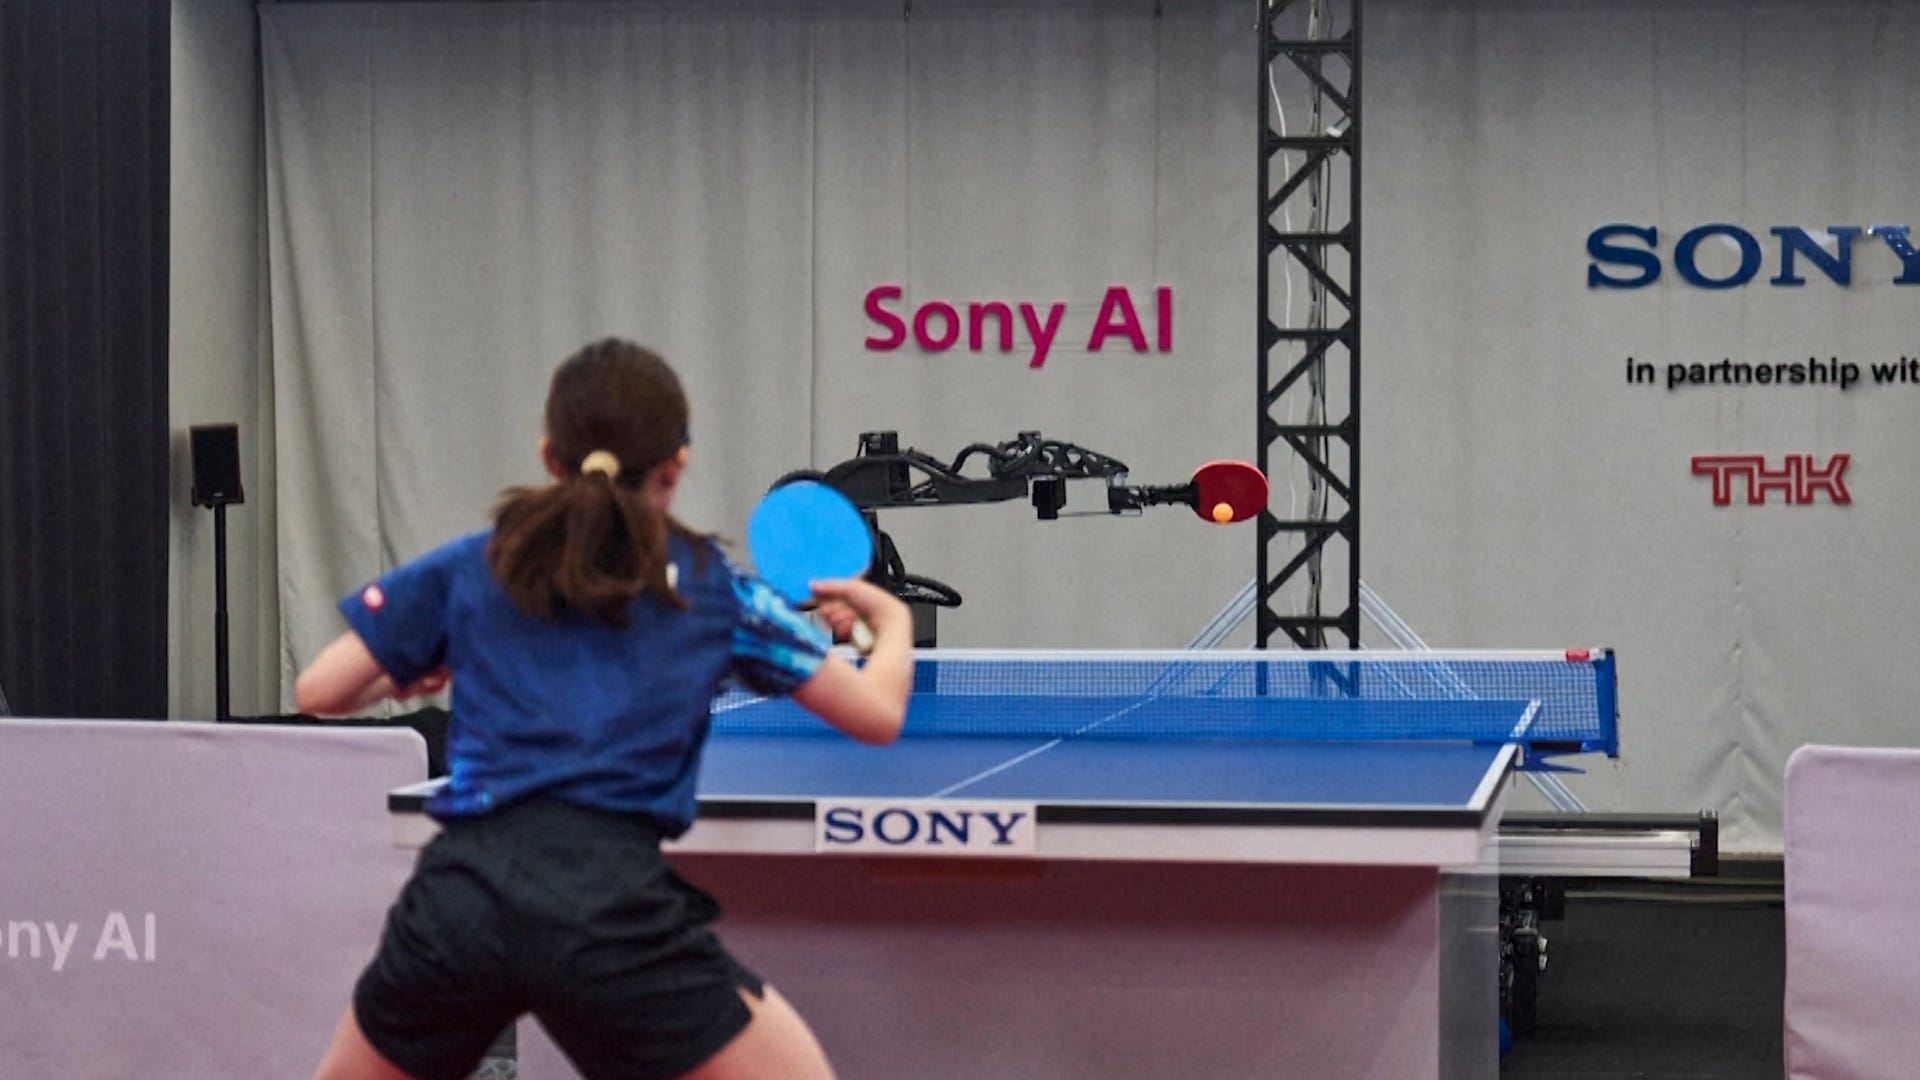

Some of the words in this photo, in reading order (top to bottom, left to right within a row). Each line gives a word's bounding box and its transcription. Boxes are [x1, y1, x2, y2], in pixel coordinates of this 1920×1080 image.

[1587, 224, 1920, 289] SONY
[864, 286, 1066, 368] Sony
[1087, 287, 1172, 352] AI
[1626, 357, 1654, 383] in
[1667, 357, 1859, 389] partnership
[1692, 454, 1851, 505] THK
[825, 807, 1026, 845] SONY
[0, 919, 79, 971] ny
[93, 912, 156, 961] AI
